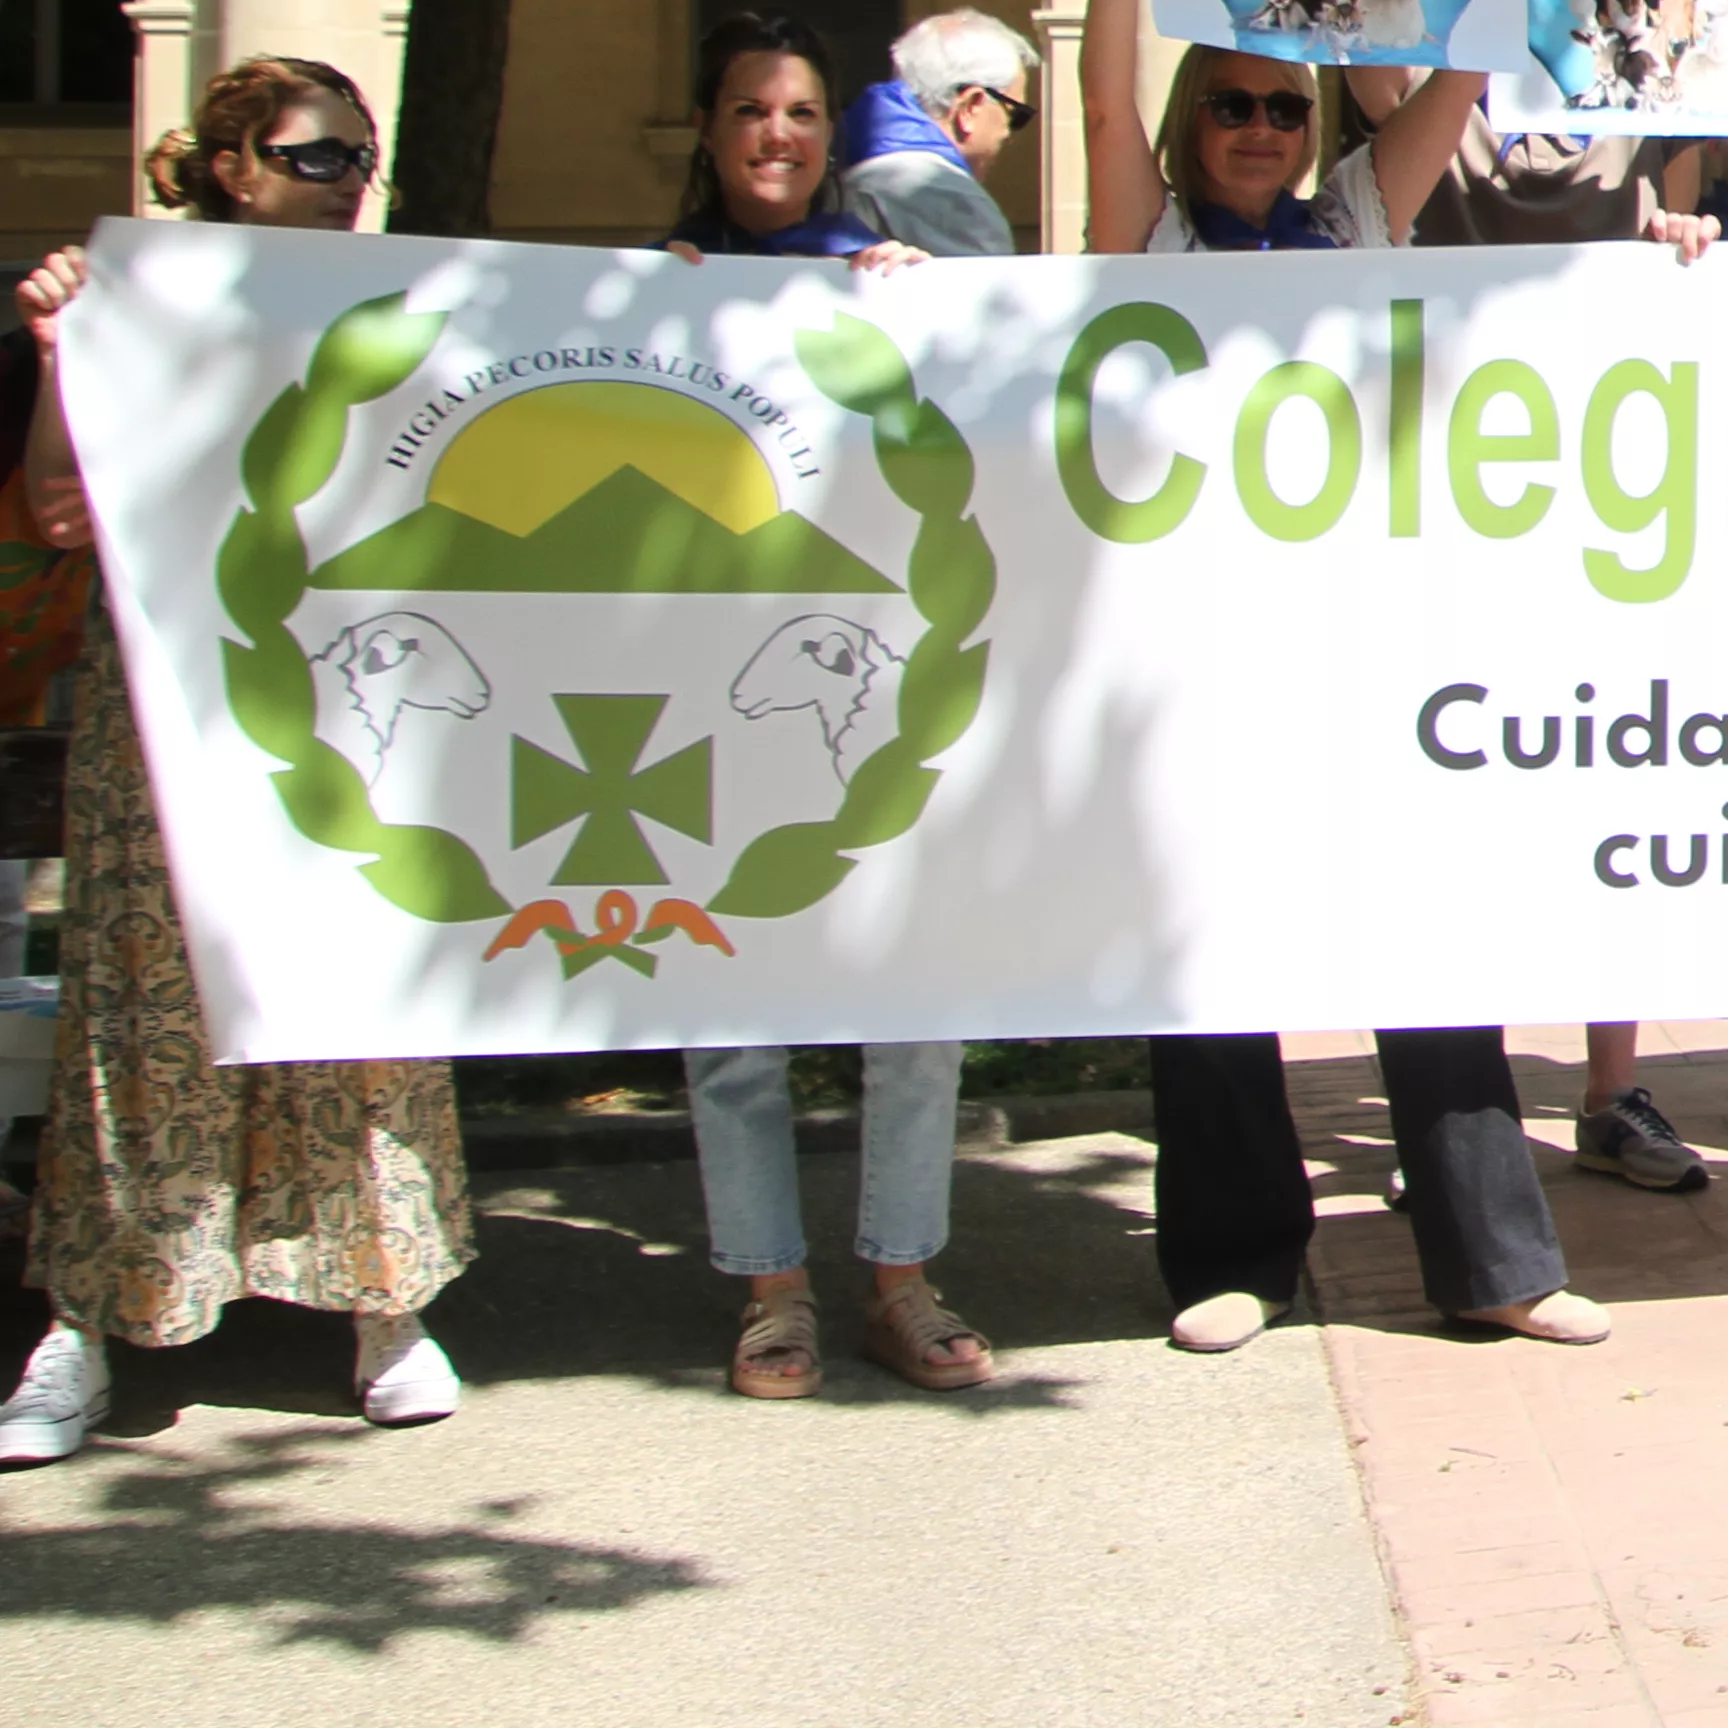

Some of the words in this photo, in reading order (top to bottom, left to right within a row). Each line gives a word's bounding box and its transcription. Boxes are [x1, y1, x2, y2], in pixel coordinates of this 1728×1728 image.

[385, 386, 465, 471] HIGIA
[464, 346, 617, 396] PECORIS
[623, 347, 728, 392] SALUS
[728, 382, 822, 480] POPULI
